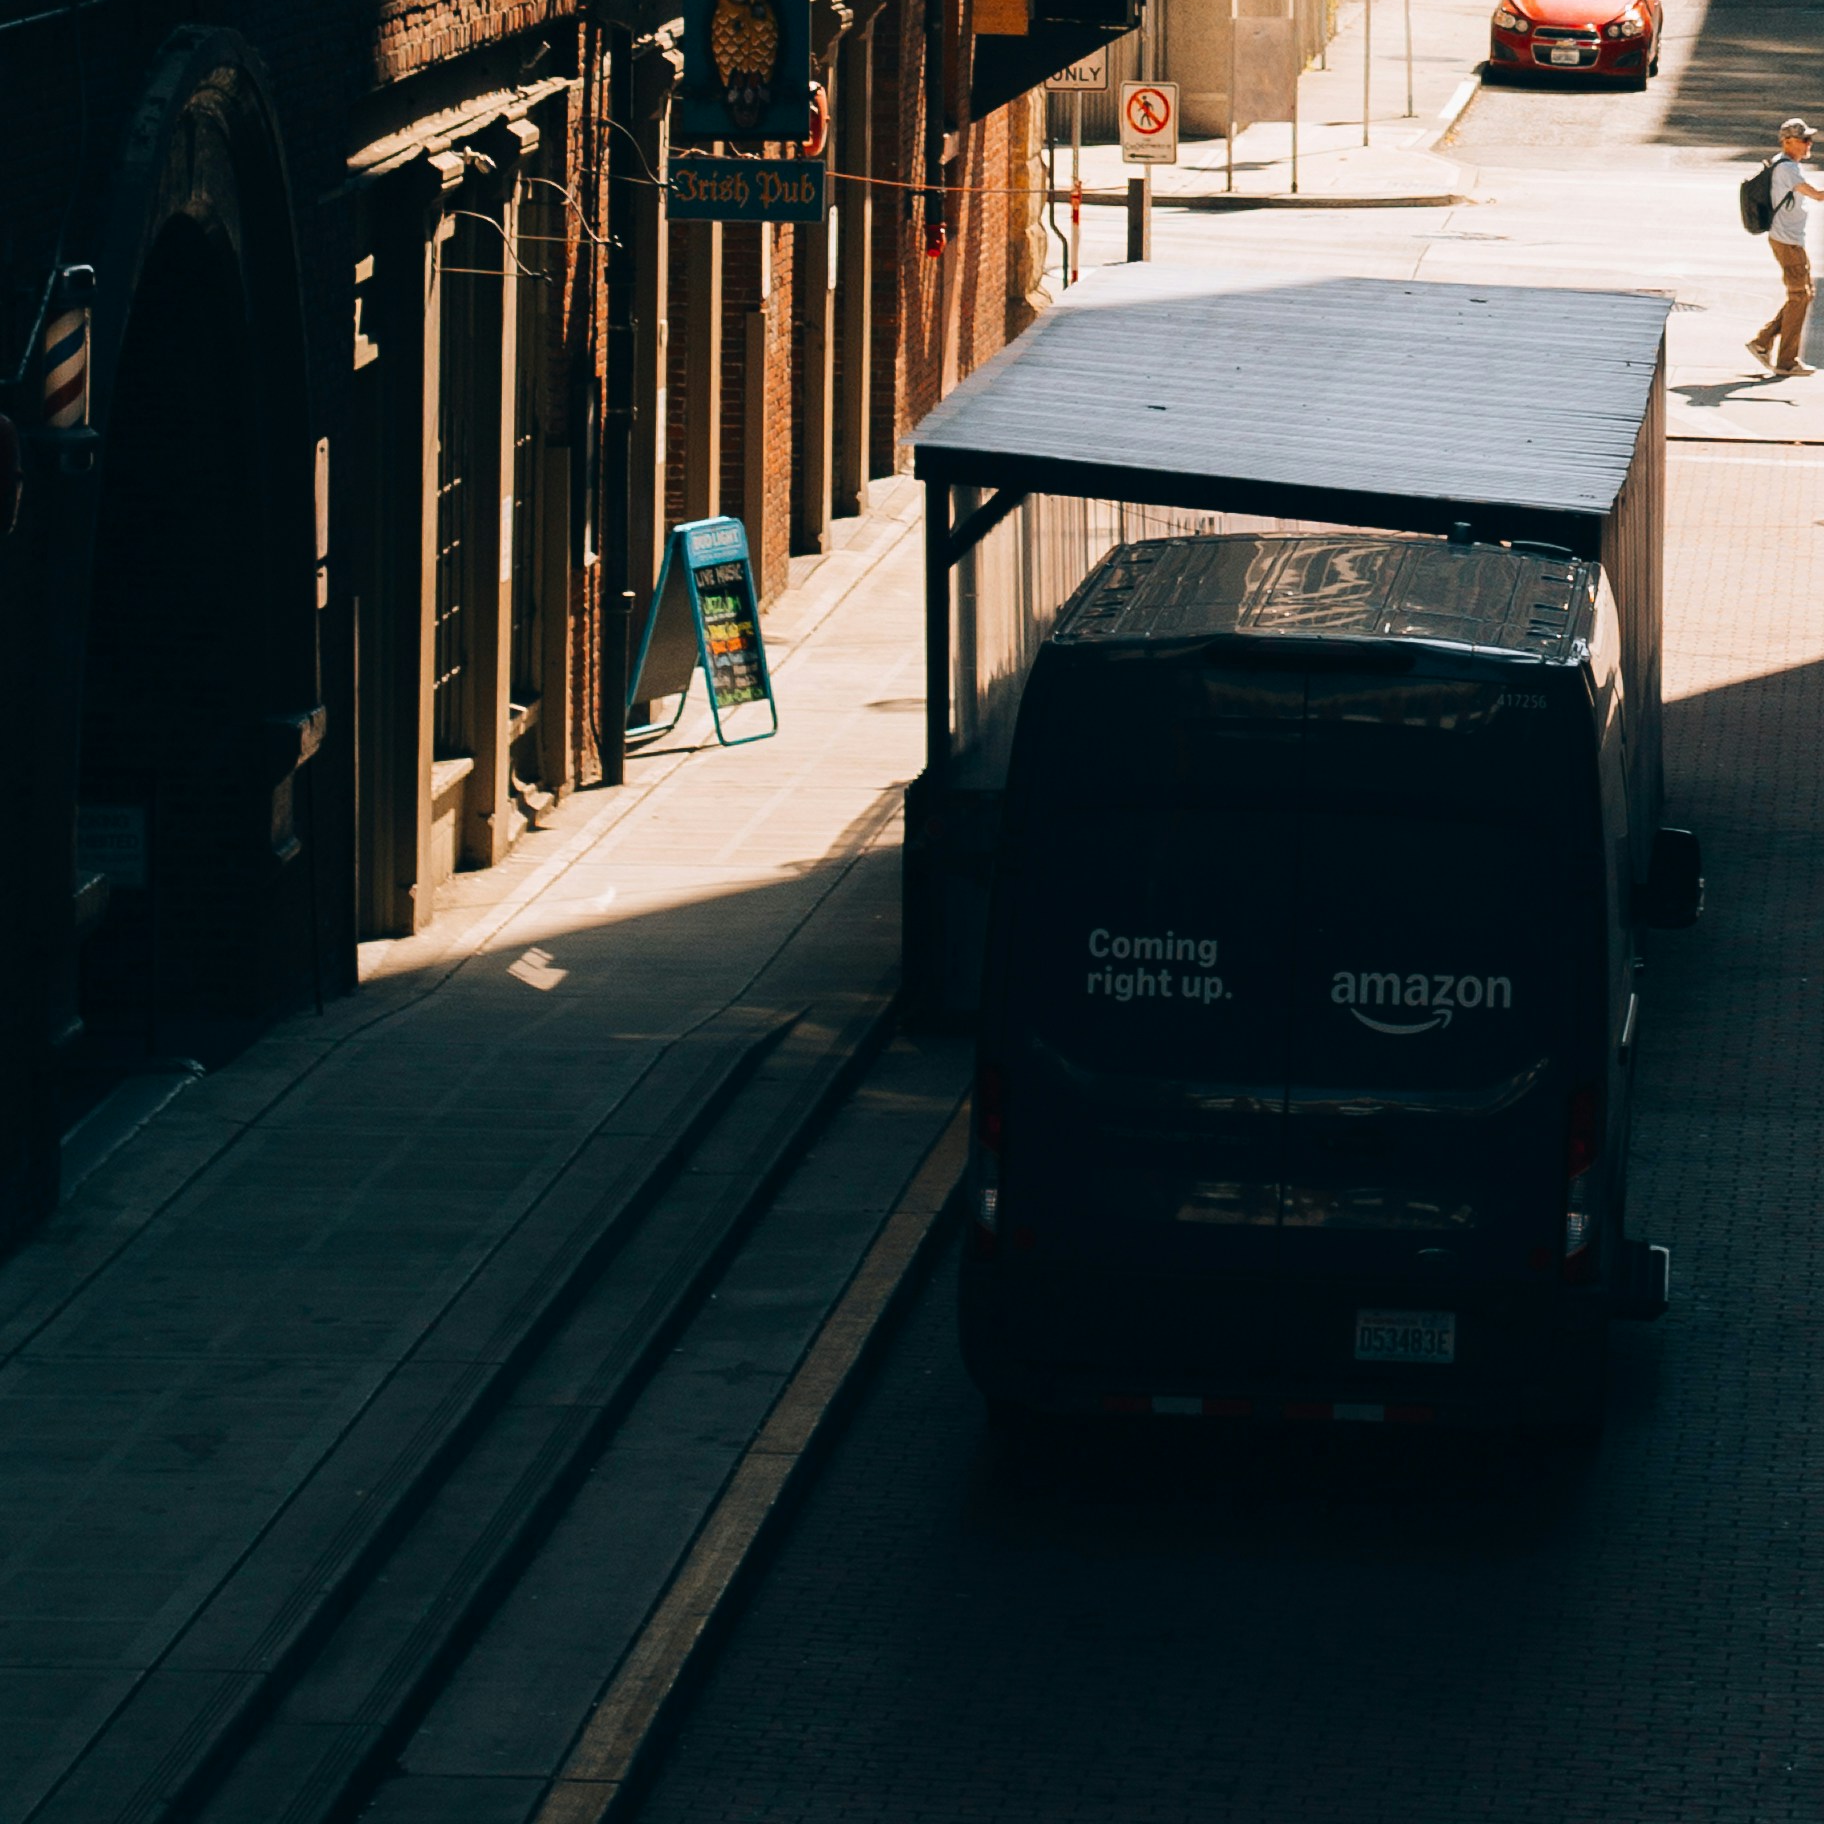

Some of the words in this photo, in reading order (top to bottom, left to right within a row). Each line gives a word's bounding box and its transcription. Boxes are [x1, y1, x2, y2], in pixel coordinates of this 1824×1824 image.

[674, 169, 750, 211] Irish
[756, 171, 816, 210] Pub
[1088, 928, 1218, 968] Coming
[1087, 966, 1171, 1001] right
[1181, 977, 1233, 1004] up.
[1331, 970, 1512, 1009] amazon
